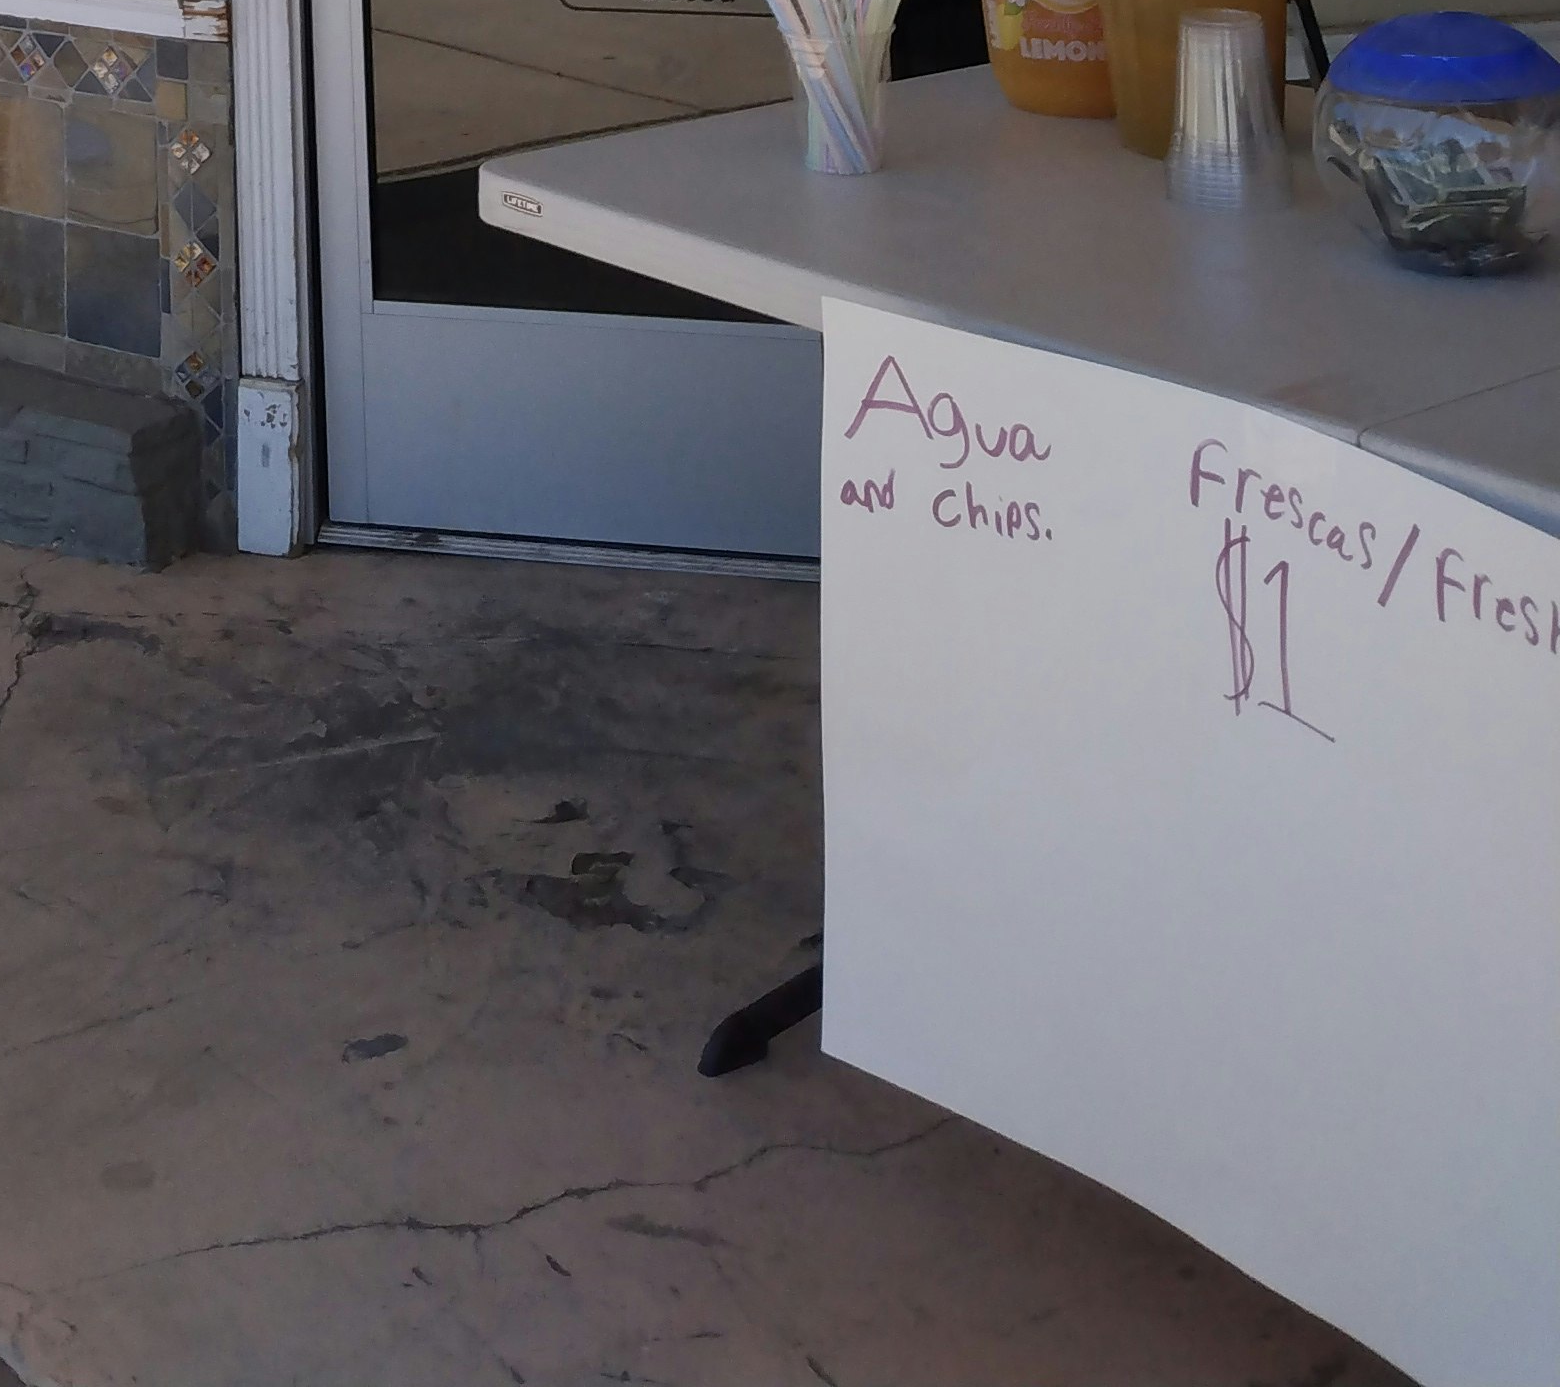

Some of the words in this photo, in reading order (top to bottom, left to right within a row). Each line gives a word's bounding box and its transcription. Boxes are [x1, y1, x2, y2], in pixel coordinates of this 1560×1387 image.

[844, 355, 1052, 469] Agua
[840, 468, 896, 513] and
[1216, 517, 1336, 743] $1
